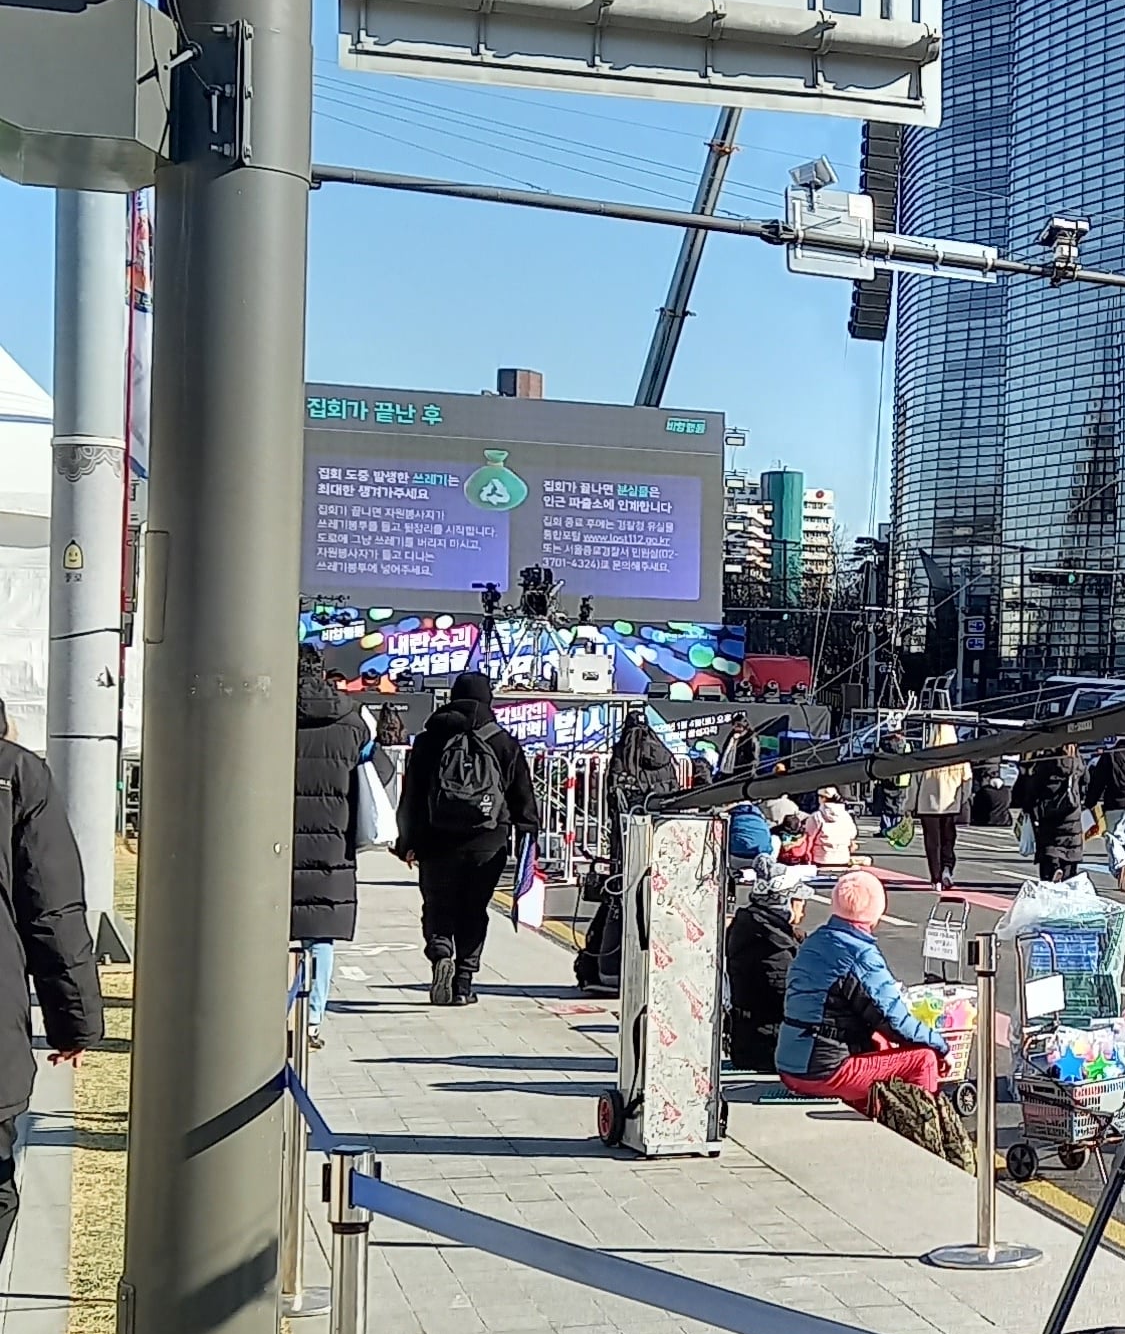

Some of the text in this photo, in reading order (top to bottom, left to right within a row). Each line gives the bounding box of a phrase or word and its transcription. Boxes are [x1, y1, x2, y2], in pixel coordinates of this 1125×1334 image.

[307, 397, 443, 426] 집회가 끝난 후
[318, 467, 460, 487] 집회 도중 발생한 쓰레기는
[318, 483, 355, 497] 최대한
[543, 480, 661, 498] 집회가 끝나면 분실물은
[543, 496, 672, 514] 인근 파출소에 인계합니다
[583, 532, 671, 546] www.lost112.go.kr
[388, 625, 473, 656] 내란수괴
